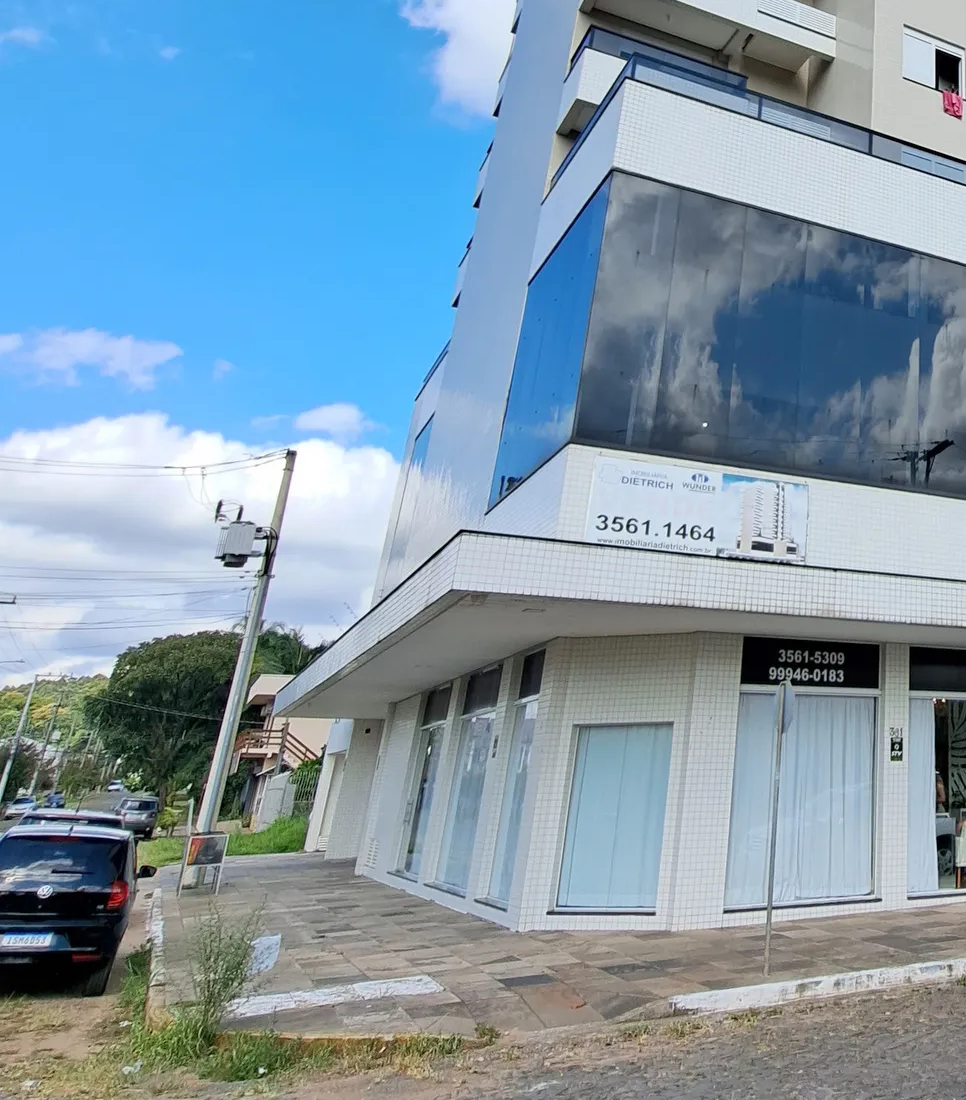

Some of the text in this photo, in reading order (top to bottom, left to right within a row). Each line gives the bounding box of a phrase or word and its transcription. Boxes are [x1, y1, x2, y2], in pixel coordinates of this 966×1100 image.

[620, 476, 674, 490] DIETRICH
[682, 481, 716, 492] WUNDER
[595, 514, 716, 542] 3561.1464
[778, 649, 845, 665] 3561-5309
[768, 666, 845, 683] 99946-0183
